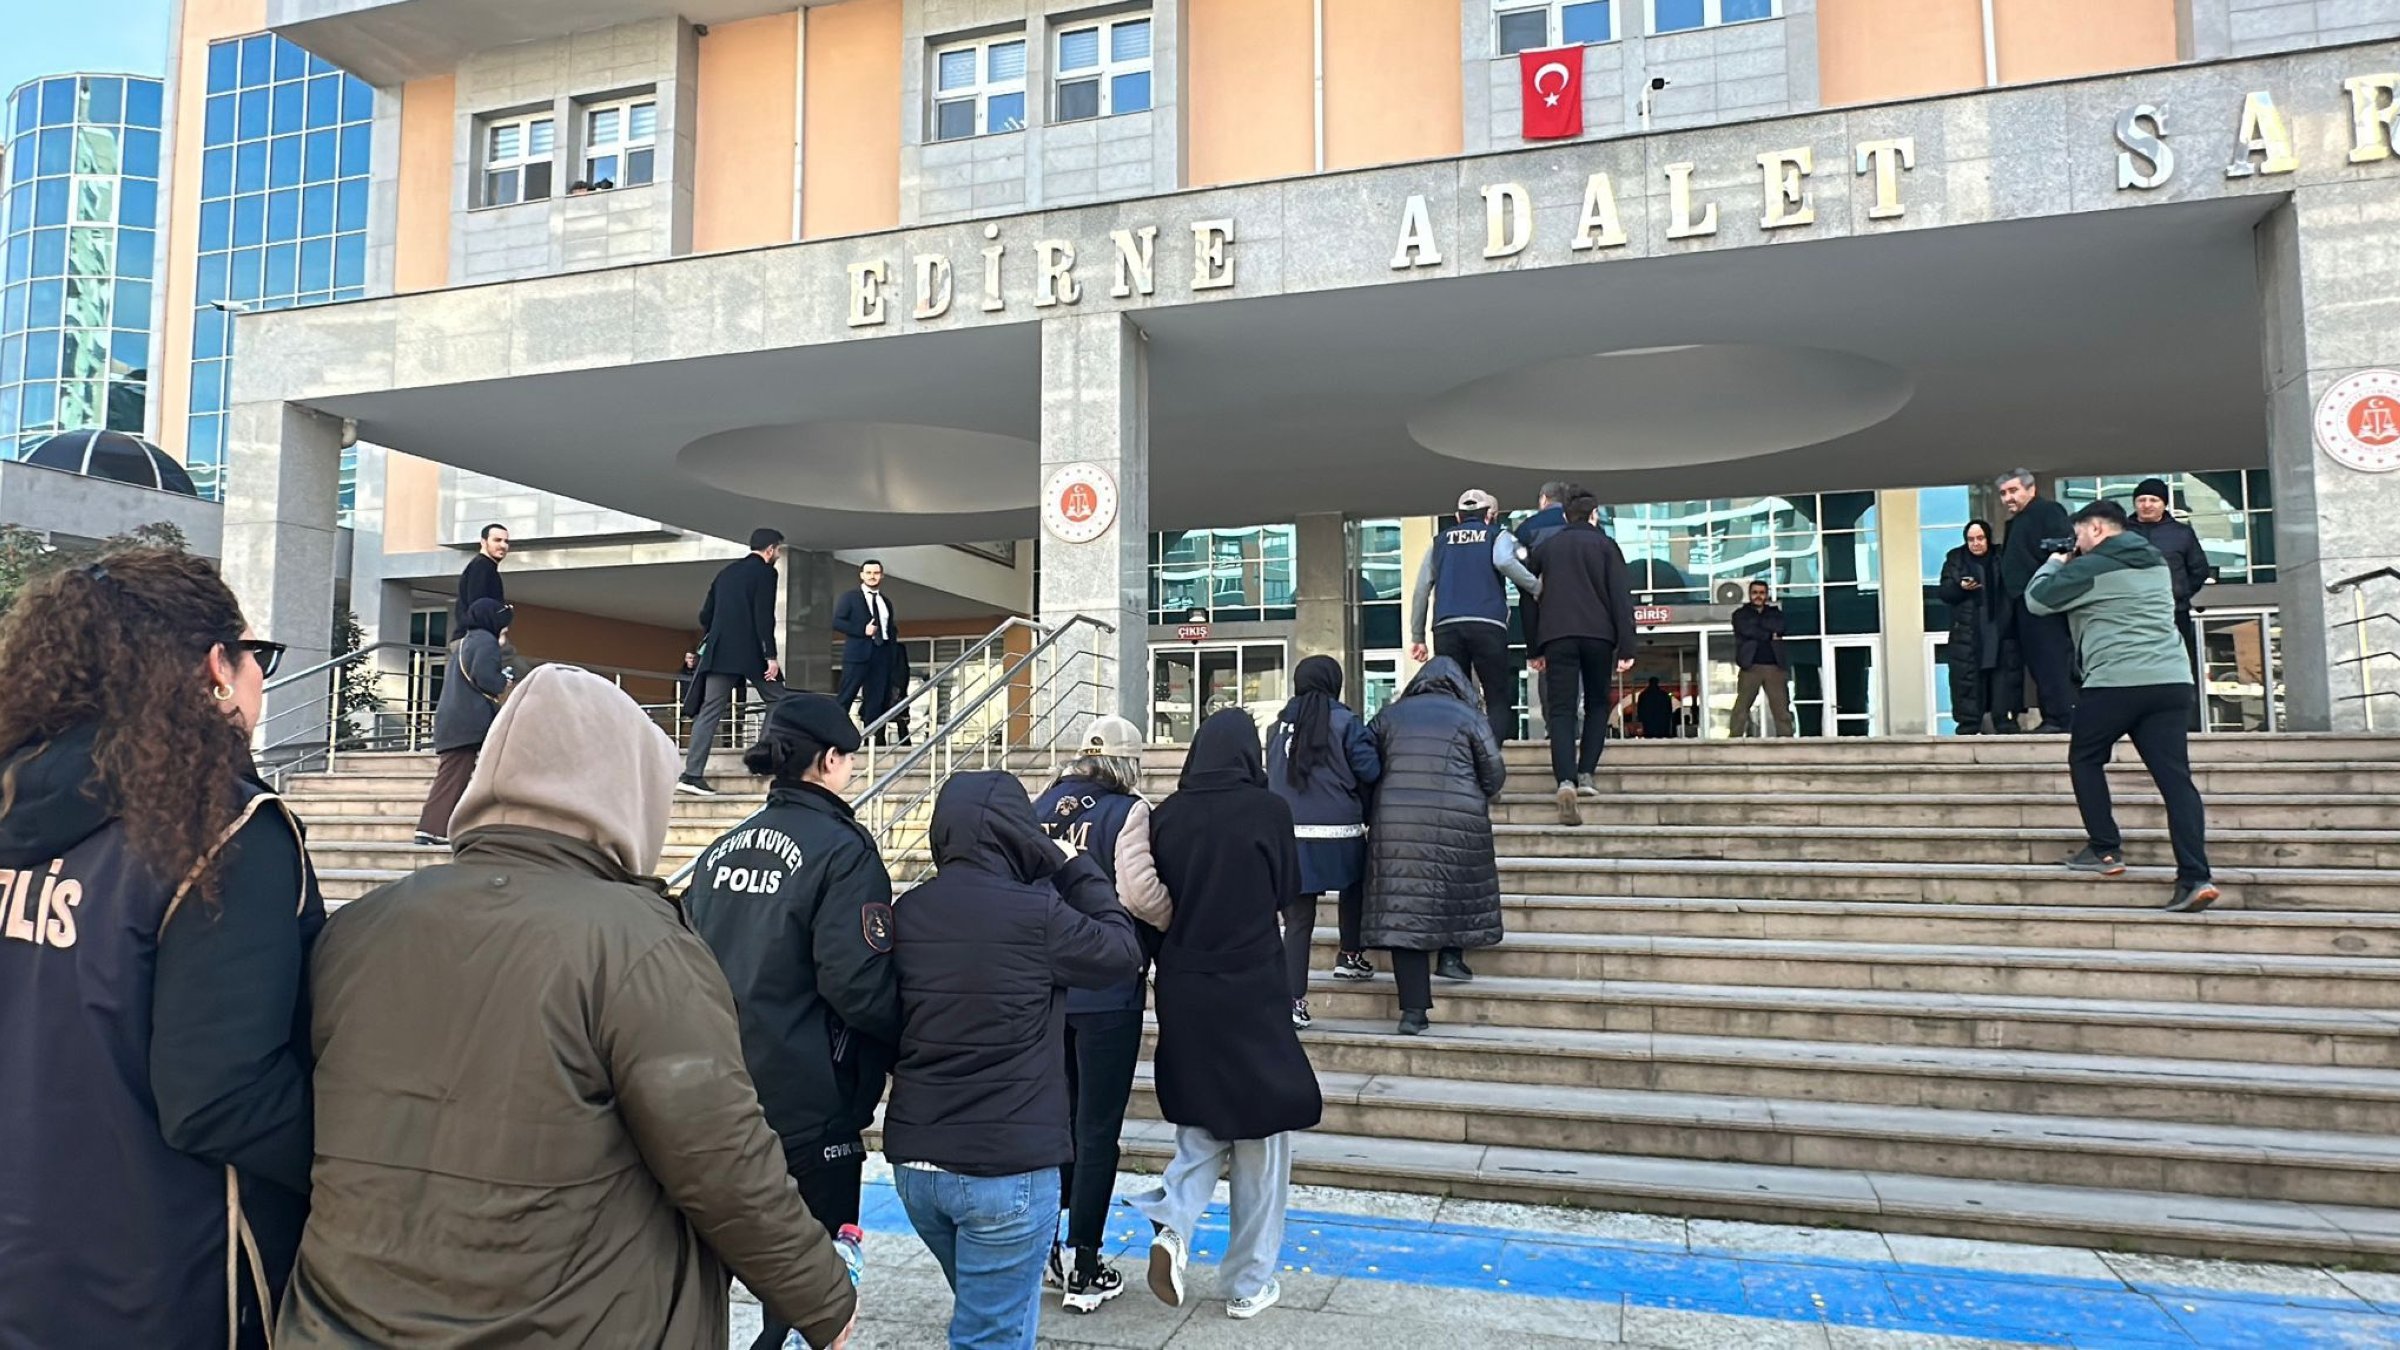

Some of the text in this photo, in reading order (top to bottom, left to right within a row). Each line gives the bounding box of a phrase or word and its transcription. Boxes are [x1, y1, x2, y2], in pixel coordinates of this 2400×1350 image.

[847, 218, 1236, 327] EDİRNE
[1390, 137, 1915, 271] ADALET
[1446, 529, 1487, 545] TEM
[1633, 607, 1668, 622] GİRİŞ
[755, 828, 804, 877] KUVVET
